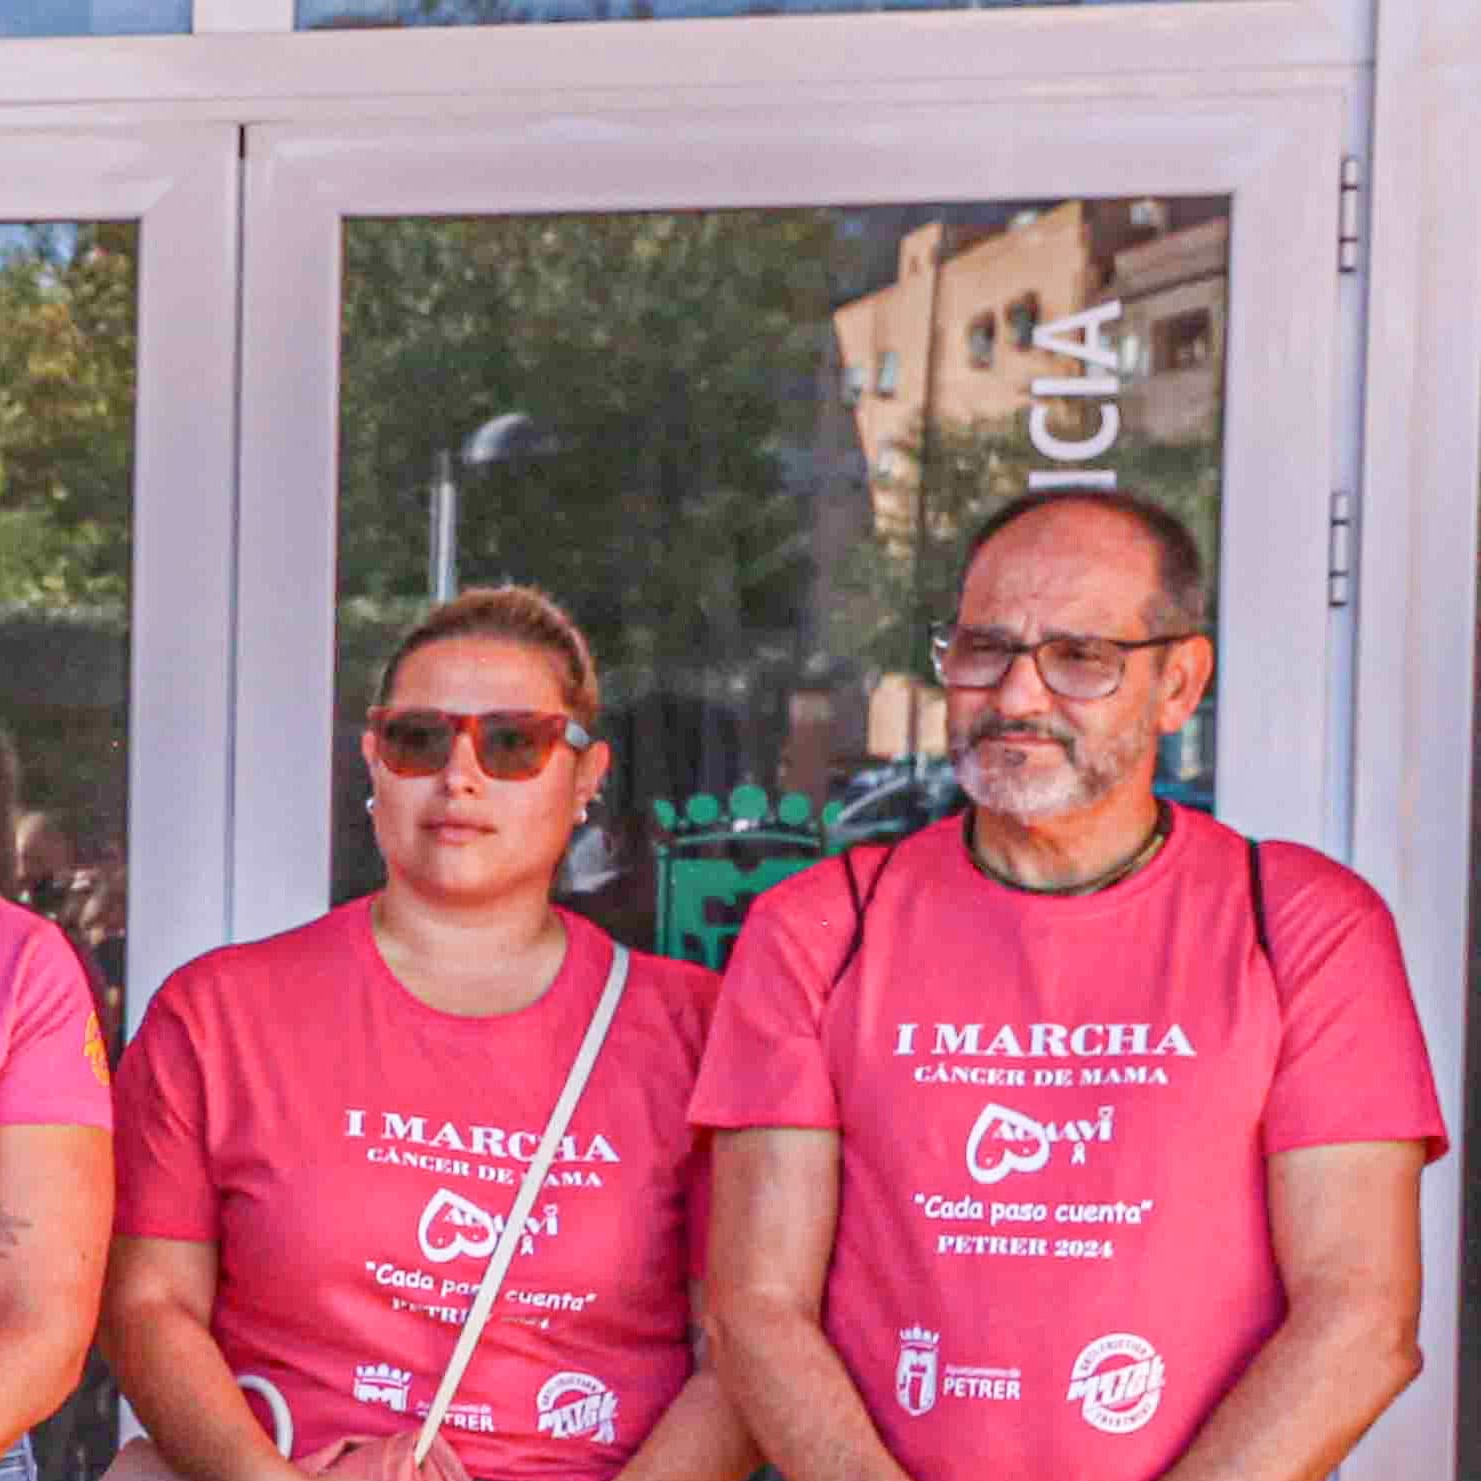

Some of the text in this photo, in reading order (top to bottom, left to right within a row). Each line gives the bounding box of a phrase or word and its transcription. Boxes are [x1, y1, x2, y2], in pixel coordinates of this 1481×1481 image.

[895, 1023, 1197, 1057] I MARCHA
[914, 1063, 1169, 1086] CÁNCER DE MAMA
[345, 1110, 366, 1137] I
[367, 1148, 471, 1177] CÁNCER
[478, 1165, 514, 1185] DE
[990, 1203, 1048, 1227] paso
[937, 1235, 1115, 1259] PETRER 2024
[942, 1376, 1021, 1401] PETRER
